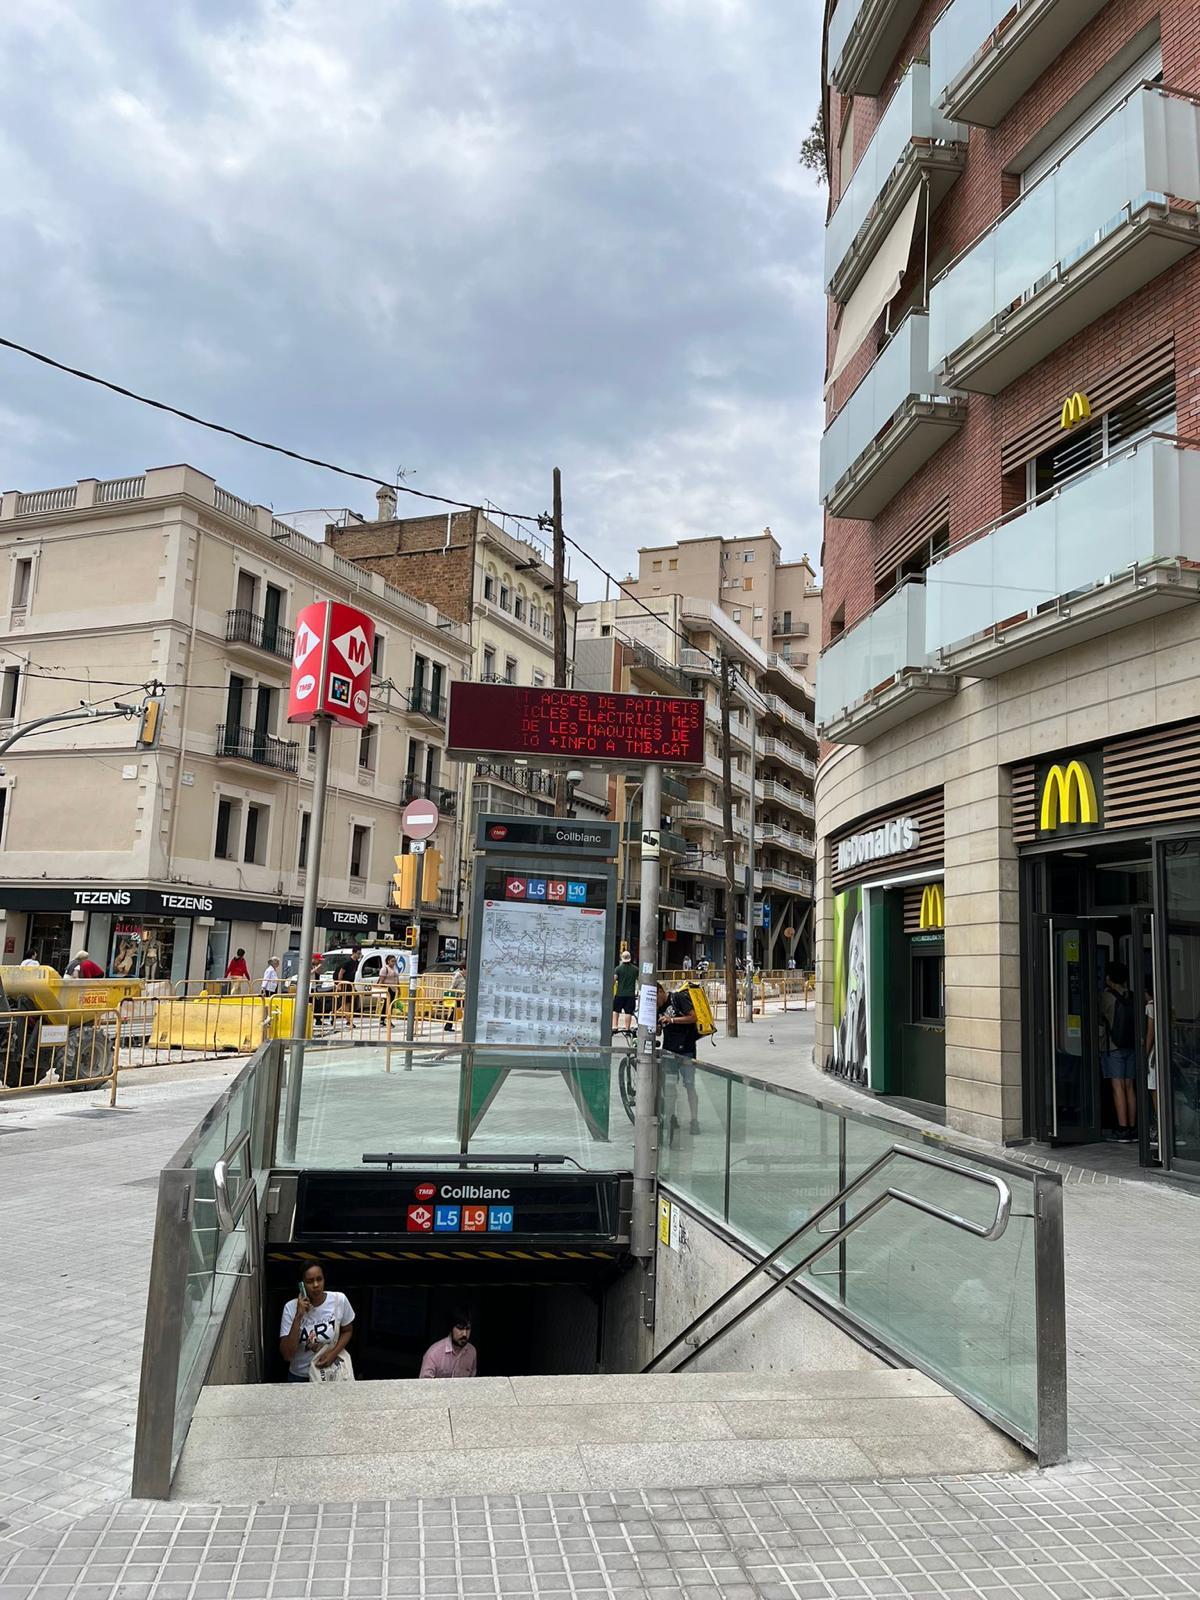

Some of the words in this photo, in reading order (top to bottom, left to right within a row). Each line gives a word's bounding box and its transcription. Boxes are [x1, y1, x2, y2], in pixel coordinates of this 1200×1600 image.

[295, 631, 309, 658] M
[348, 634, 366, 666] M
[598, 696, 616, 709] DE
[625, 698, 699, 714] PATINETS
[550, 721, 578, 735] LES
[671, 729, 690, 742] DE
[606, 739, 616, 752] A
[625, 740, 690, 757] TMB.CAT
[556, 830, 601, 843] Collblanc
[528, 883, 545, 895] L5
[549, 883, 565, 895] L9
[568, 884, 585, 896] L10
[440, 1185, 511, 1199] Collblanc
[436, 1210, 458, 1226] L5
[464, 1210, 485, 1225] L9
[490, 1211, 512, 1225] L10
